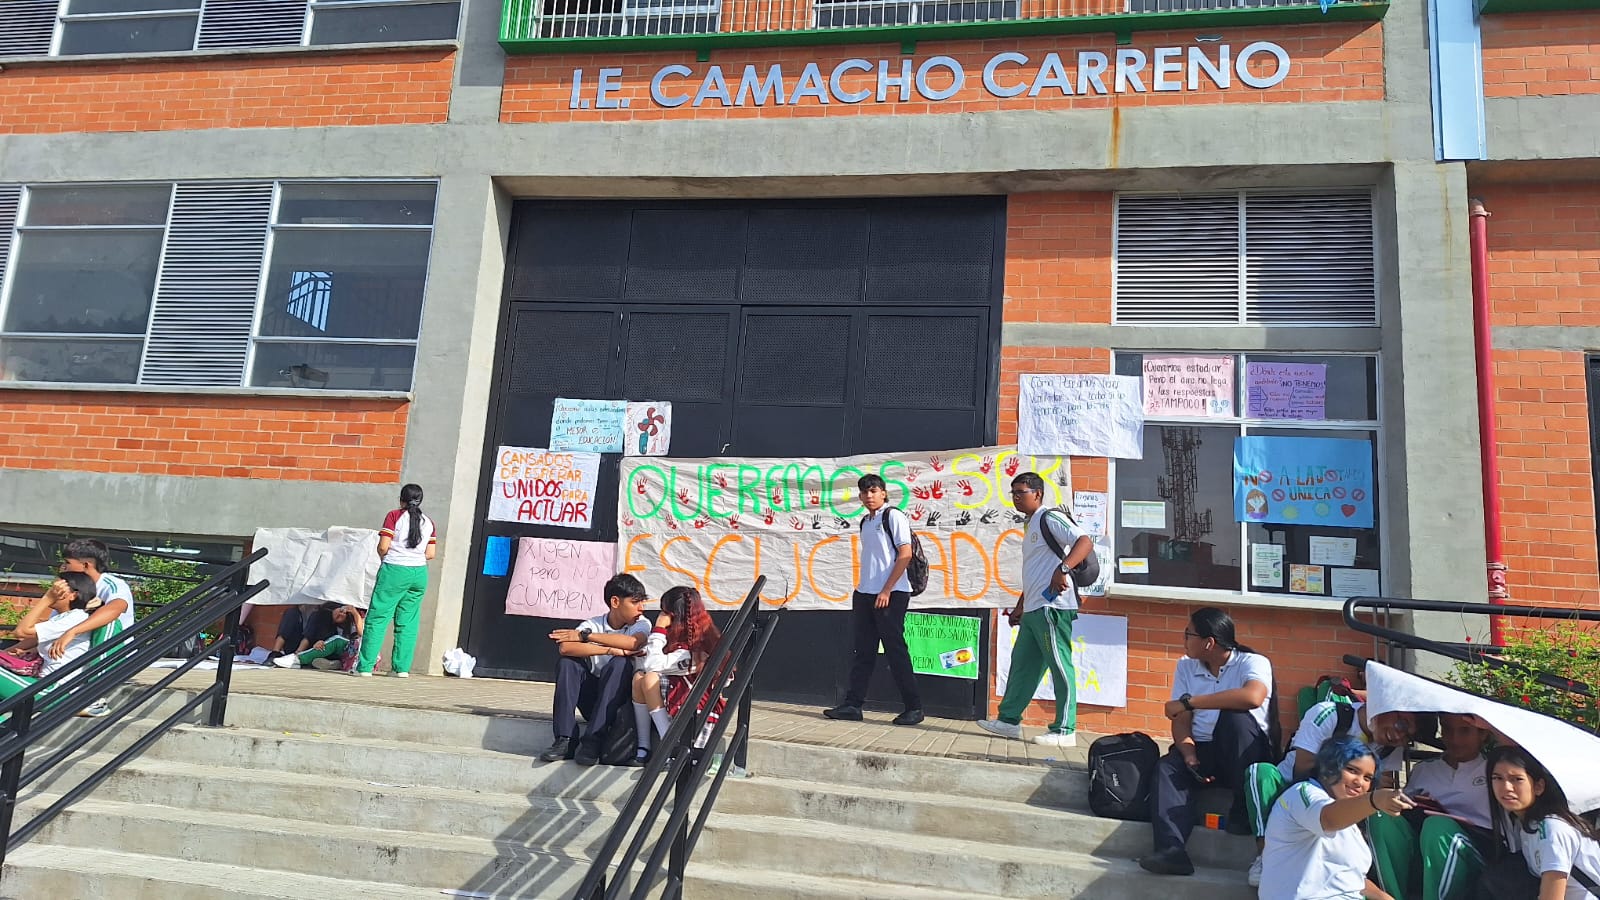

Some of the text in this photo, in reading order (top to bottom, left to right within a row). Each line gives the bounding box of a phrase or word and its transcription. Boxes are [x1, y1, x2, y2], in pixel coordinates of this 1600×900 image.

[569, 34, 1291, 109] I.E. CAMACHO CARREÑO
[1169, 375, 1176, 384] el
[501, 450, 574, 467] CANSADOS
[501, 467, 582, 482] DE ESPERAR
[503, 479, 588, 501] UNIDOS PARA
[627, 461, 910, 521] QUEREMOS
[517, 500, 588, 522] ACTUAR
[624, 528, 1025, 607] ESCUCADO
